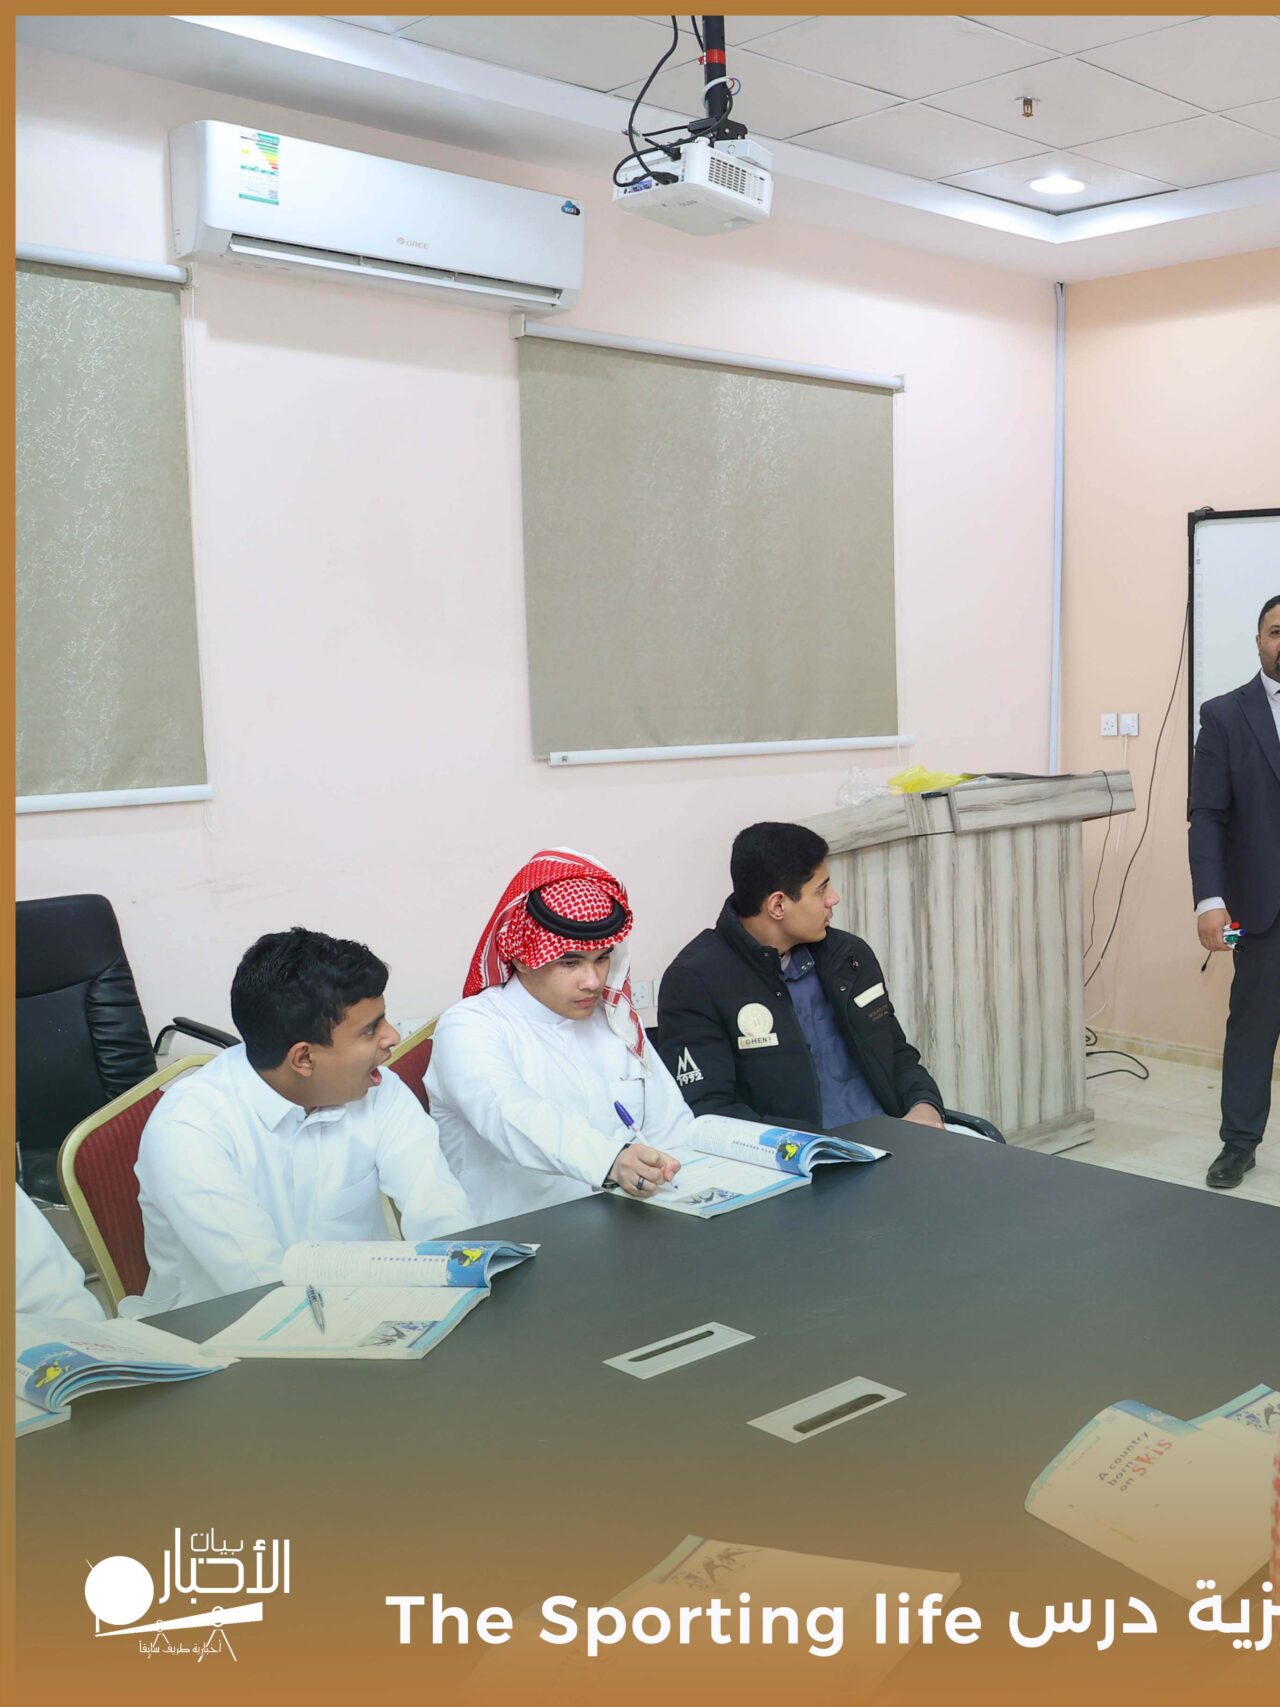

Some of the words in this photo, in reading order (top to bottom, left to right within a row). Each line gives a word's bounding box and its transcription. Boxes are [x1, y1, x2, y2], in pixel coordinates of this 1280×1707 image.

[1109, 1431, 1150, 1471] country
[1107, 1460, 1135, 1487] born
[1119, 1477, 1134, 1492] on
